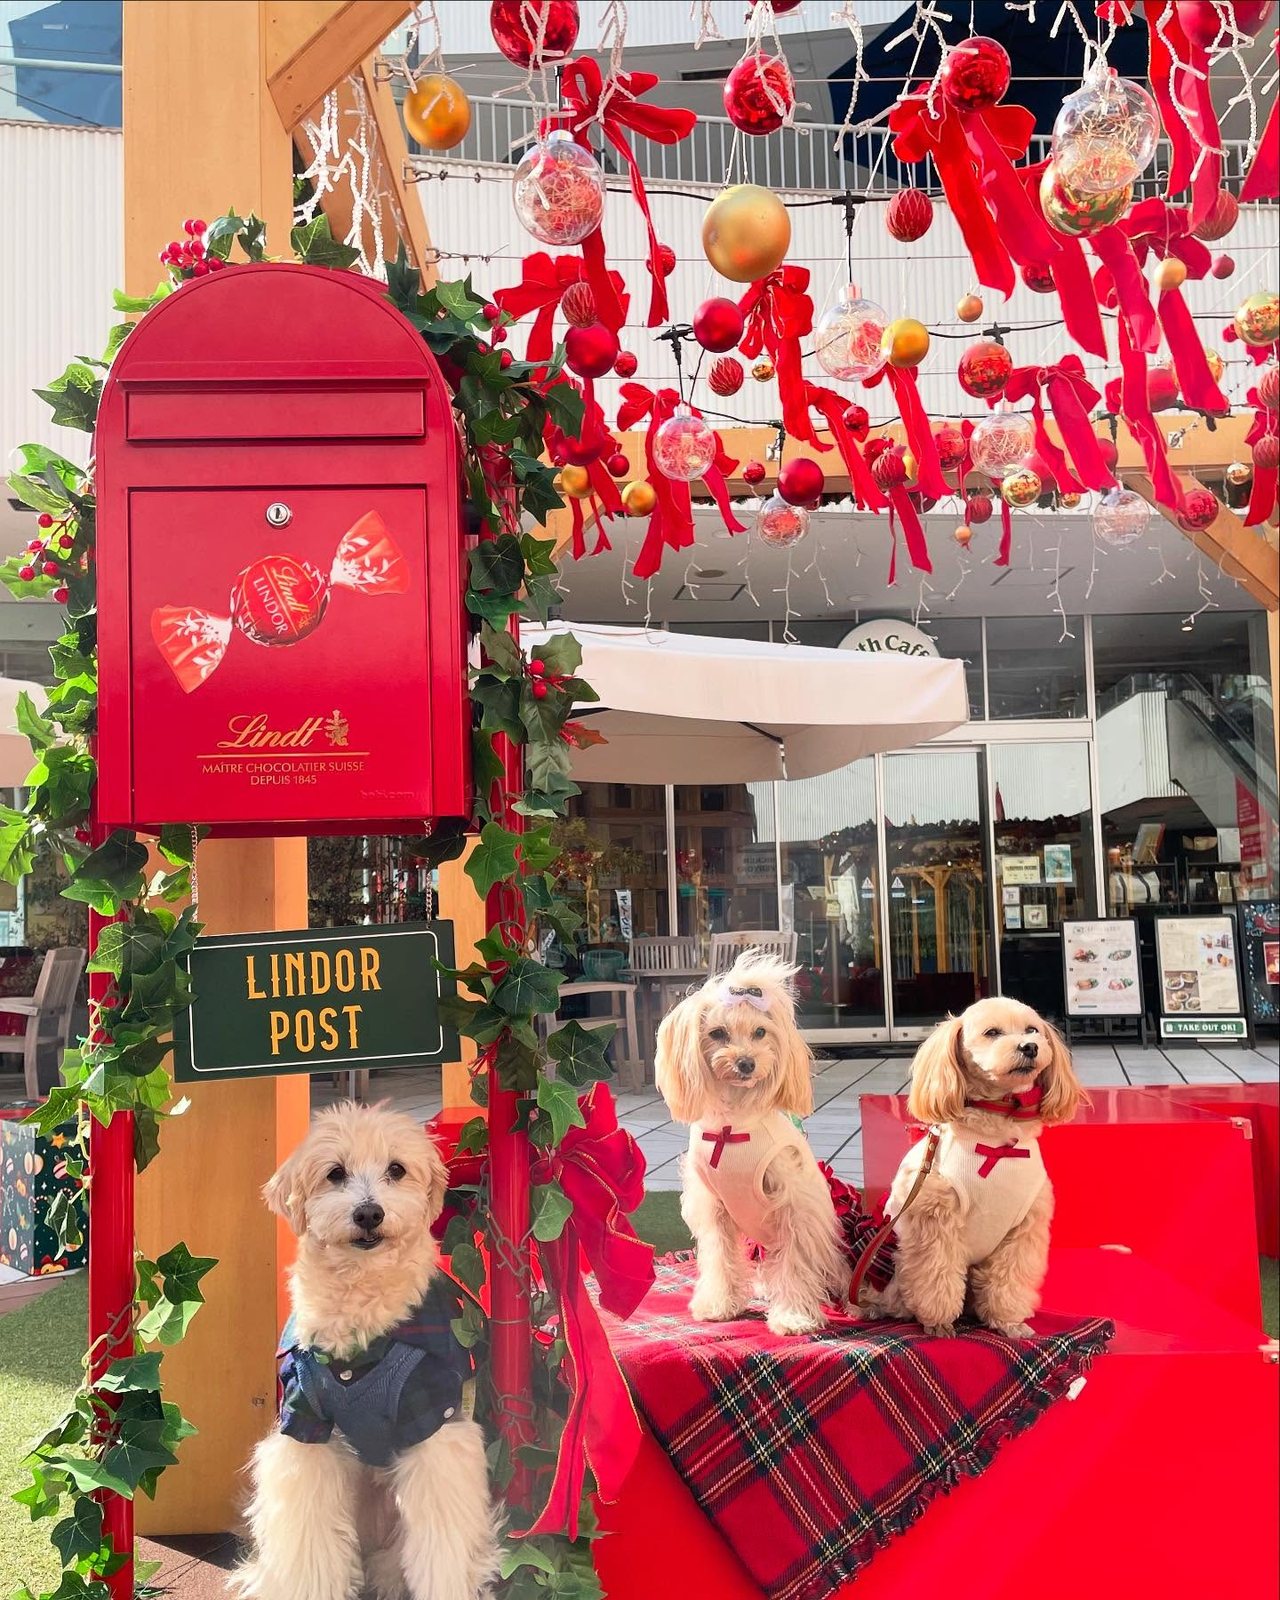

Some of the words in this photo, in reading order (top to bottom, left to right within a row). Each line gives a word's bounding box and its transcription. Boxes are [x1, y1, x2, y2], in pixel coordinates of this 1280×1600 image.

[253, 577, 288, 634] LINDOR
[855, 637, 882, 652] th
[217, 714, 323, 748] Lindt
[245, 761, 327, 773] CHOCOLATIER
[328, 761, 365, 772] SUISSE
[250, 775, 291, 785] DEPUIS
[292, 775, 317, 785] 1845
[246, 947, 382, 1000] LINDOR
[270, 1005, 363, 1055] POST
[1177, 1023, 1200, 1032] TAKE
[1202, 1023, 1219, 1032] OUT
